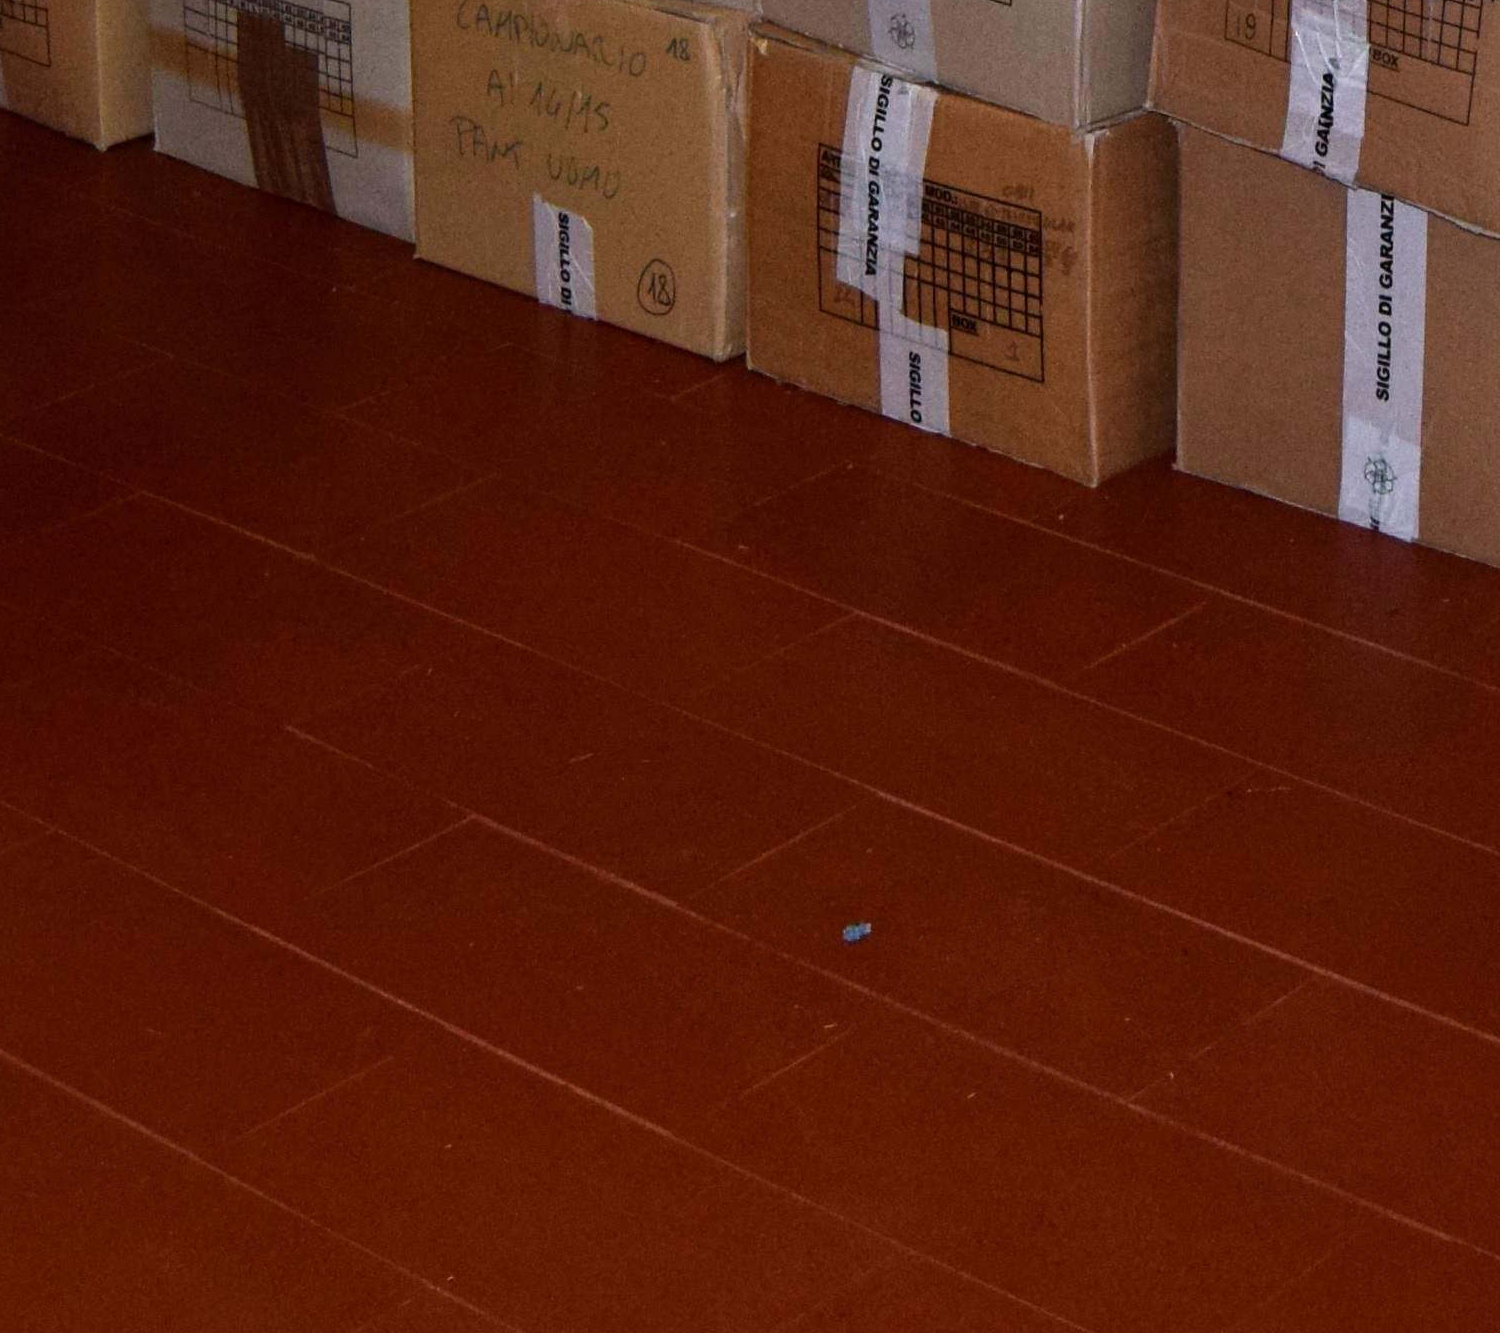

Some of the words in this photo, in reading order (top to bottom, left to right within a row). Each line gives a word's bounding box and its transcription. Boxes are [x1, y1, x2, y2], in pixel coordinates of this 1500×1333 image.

[666, 37, 691, 62] 18
[1371, 48, 1399, 67] BOX
[870, 74, 894, 152] SIGILLO
[868, 156, 881, 175] DI
[864, 176, 882, 277] GARANZIA
[558, 212, 572, 283] SIGILLO
[646, 274, 672, 307] 18
[1378, 294, 1393, 316] DI
[951, 314, 979, 332] BOX
[1375, 321, 1392, 402] SIGILLO
[908, 350, 923, 424] SIGILLO
